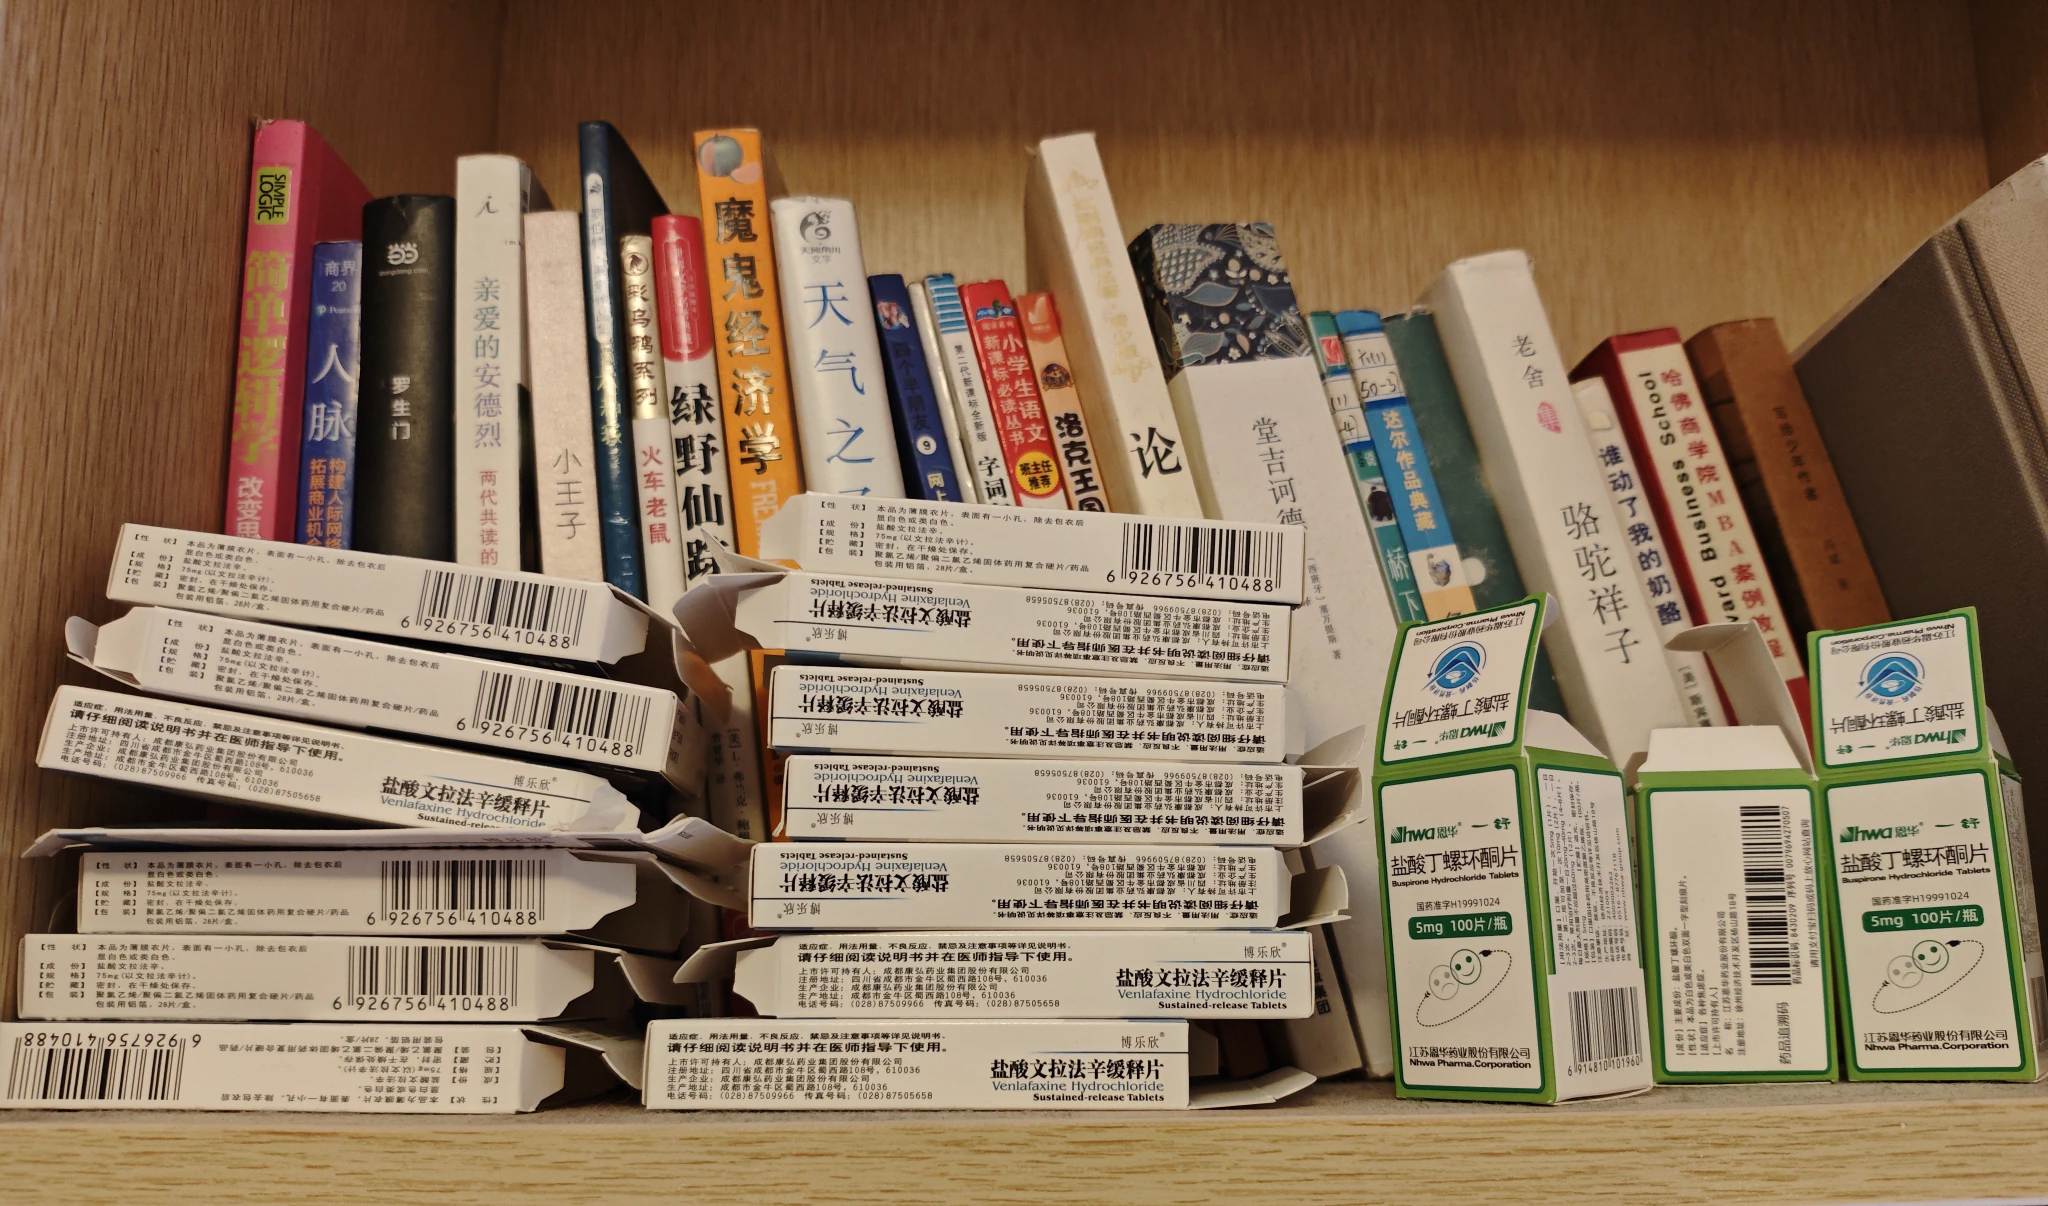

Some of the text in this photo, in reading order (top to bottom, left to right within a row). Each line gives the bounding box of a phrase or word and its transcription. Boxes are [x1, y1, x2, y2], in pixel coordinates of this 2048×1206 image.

[257, 174, 274, 220] LOGIC
[273, 174, 286, 218] SIMPLE
[324, 260, 357, 277] 商界
[332, 281, 346, 292] 20
[628, 284, 657, 407] 彩乌鸦系列
[715, 197, 782, 476] 魔鬼经济学
[232, 250, 291, 464] 简单逻辑学
[474, 277, 502, 449] 亲爱的安德烈
[1511, 335, 1545, 389] 老舍
[308, 344, 356, 442] 人脉
[803, 281, 875, 497] 天气之
[983, 335, 1026, 448] 新课标必读丛书
[1003, 334, 1048, 444] 小学生语文
[391, 376, 411, 440] 罗生门
[1638, 372, 1676, 446] School
[922, 440, 931, 451] 9
[1130, 426, 1183, 479] 论
[1019, 461, 1054, 475] 班主任
[1382, 410, 1436, 531] 达尔作品典藏
[978, 456, 1011, 506] 字词
[1028, 475, 1053, 491] 推荐
[553, 448, 586, 540] 小王子
[641, 445, 671, 546] 火车老鼠
[480, 470, 499, 566] 两代共读的
[1672, 458, 1718, 562] Business
[1598, 445, 1682, 627] 谁动了我的奶酪
[1107, 570, 1273, 592] 6 926756 410488
[1559, 502, 1640, 665] 骆驼祥子
[810, 588, 970, 608] Venlafaxine Hydrochloride
[809, 599, 972, 628] 盐酸文拉法辛缓释片
[401, 616, 571, 649] 6 926756 410488
[799, 683, 962, 698] Venlafaxine Hydrochloride
[798, 694, 964, 718] 盐酸文拉法辛缓释片
[1392, 693, 1511, 728] 盐酸丁螺环酮片
[1829, 702, 1964, 734] 盐酸丁螺环酮片
[456, 717, 633, 757] 6 926756 410488
[814, 773, 978, 785] Venlafaxine Hydrochloride
[380, 776, 550, 819] 盐酸文拉法辛缓释片
[813, 784, 980, 805] 盐酸文拉法辛缓释片
[380, 795, 546, 828] Venlafaxine Hydrochloride
[780, 861, 947, 872] Venlafaxine Hydrochloride
[1391, 845, 1518, 876] 盐酸丁螺环酮片
[1840, 843, 1989, 873] 盐酸丁螺环酮片
[779, 873, 949, 892] 盐酸文拉法辛缓释片
[1392, 871, 1519, 887] Buspirone Hydrochloride Tablets
[1842, 875, 1886, 884] Buspirone
[1889, 870, 1953, 880] Hydrochloride
[1417, 898, 1500, 911] 国药准字H19991024
[1872, 892, 1969, 905] 国药准字H19991024
[367, 912, 537, 925] 6 926756 410488
[1416, 916, 1508, 935] 5mg 100片/瓶
[1871, 908, 1978, 927] 5mg 100片/瓶
[1116, 968, 1287, 988] 盐酸文拉法辛缓释片
[333, 997, 509, 1011] 6 926756 410488
[1118, 990, 1287, 1001] Venlafaxine Hydrochloride
[24, 1032, 96, 1047] 410488
[107, 1033, 178, 1047] 926756
[1776, 1002, 1791, 1065] 药品追溯码
[1864, 1030, 2007, 1043] 江苏恩华药业股份有限公司
[1409, 1046, 1530, 1059] 江苏恩华药业股份有限公司
[1865, 1042, 2009, 1051] Nhwa Pharma.Corporation
[990, 1059, 1164, 1080] 盐酸文拉法辛缓释片
[1438, 1060, 1531, 1069] Pharma.Corporation
[1567, 1054, 1640, 1077] 6 914810 101960
[992, 1081, 1164, 1093] Venlafaxine Hydrochloride
[1033, 1093, 1125, 1102] Sustained-release
